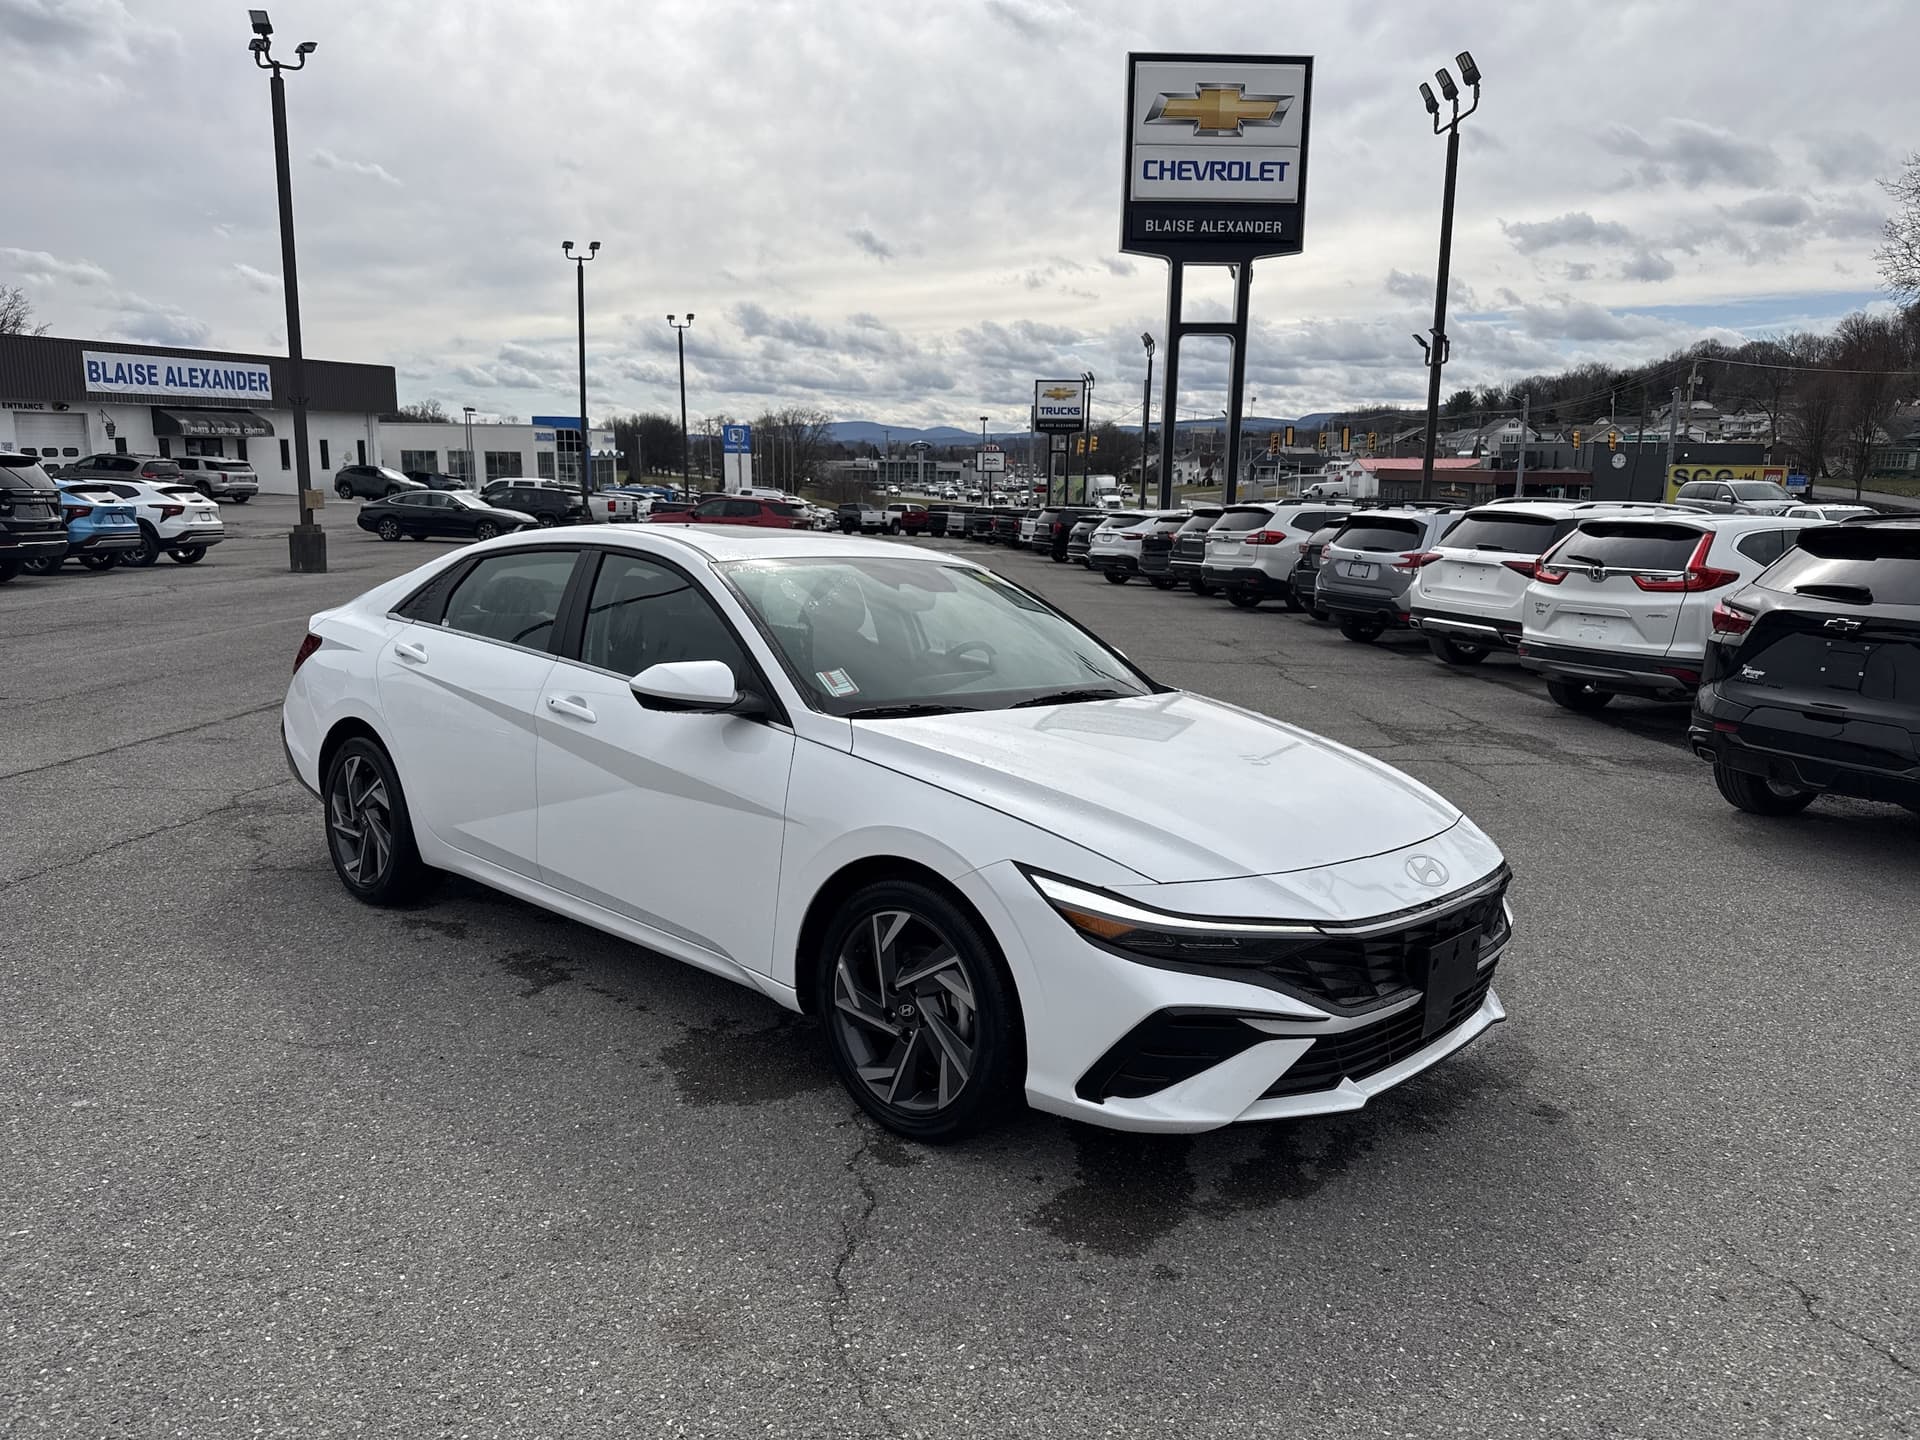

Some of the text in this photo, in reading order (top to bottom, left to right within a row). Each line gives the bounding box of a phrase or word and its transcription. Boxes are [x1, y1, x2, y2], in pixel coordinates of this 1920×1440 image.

[1143, 160, 1290, 182] CHEVROLET
[1145, 219, 1282, 234] BLAISE ALEXANDER
[87, 360, 270, 392] BLAISE ALEXANDER
[1, 402, 45, 410] ENTRANCE
[1040, 407, 1081, 415] TRUCKS
[190, 425, 209, 433] PARTS
[217, 426, 241, 434] SERVICE
[243, 426, 266, 434] CENTER
